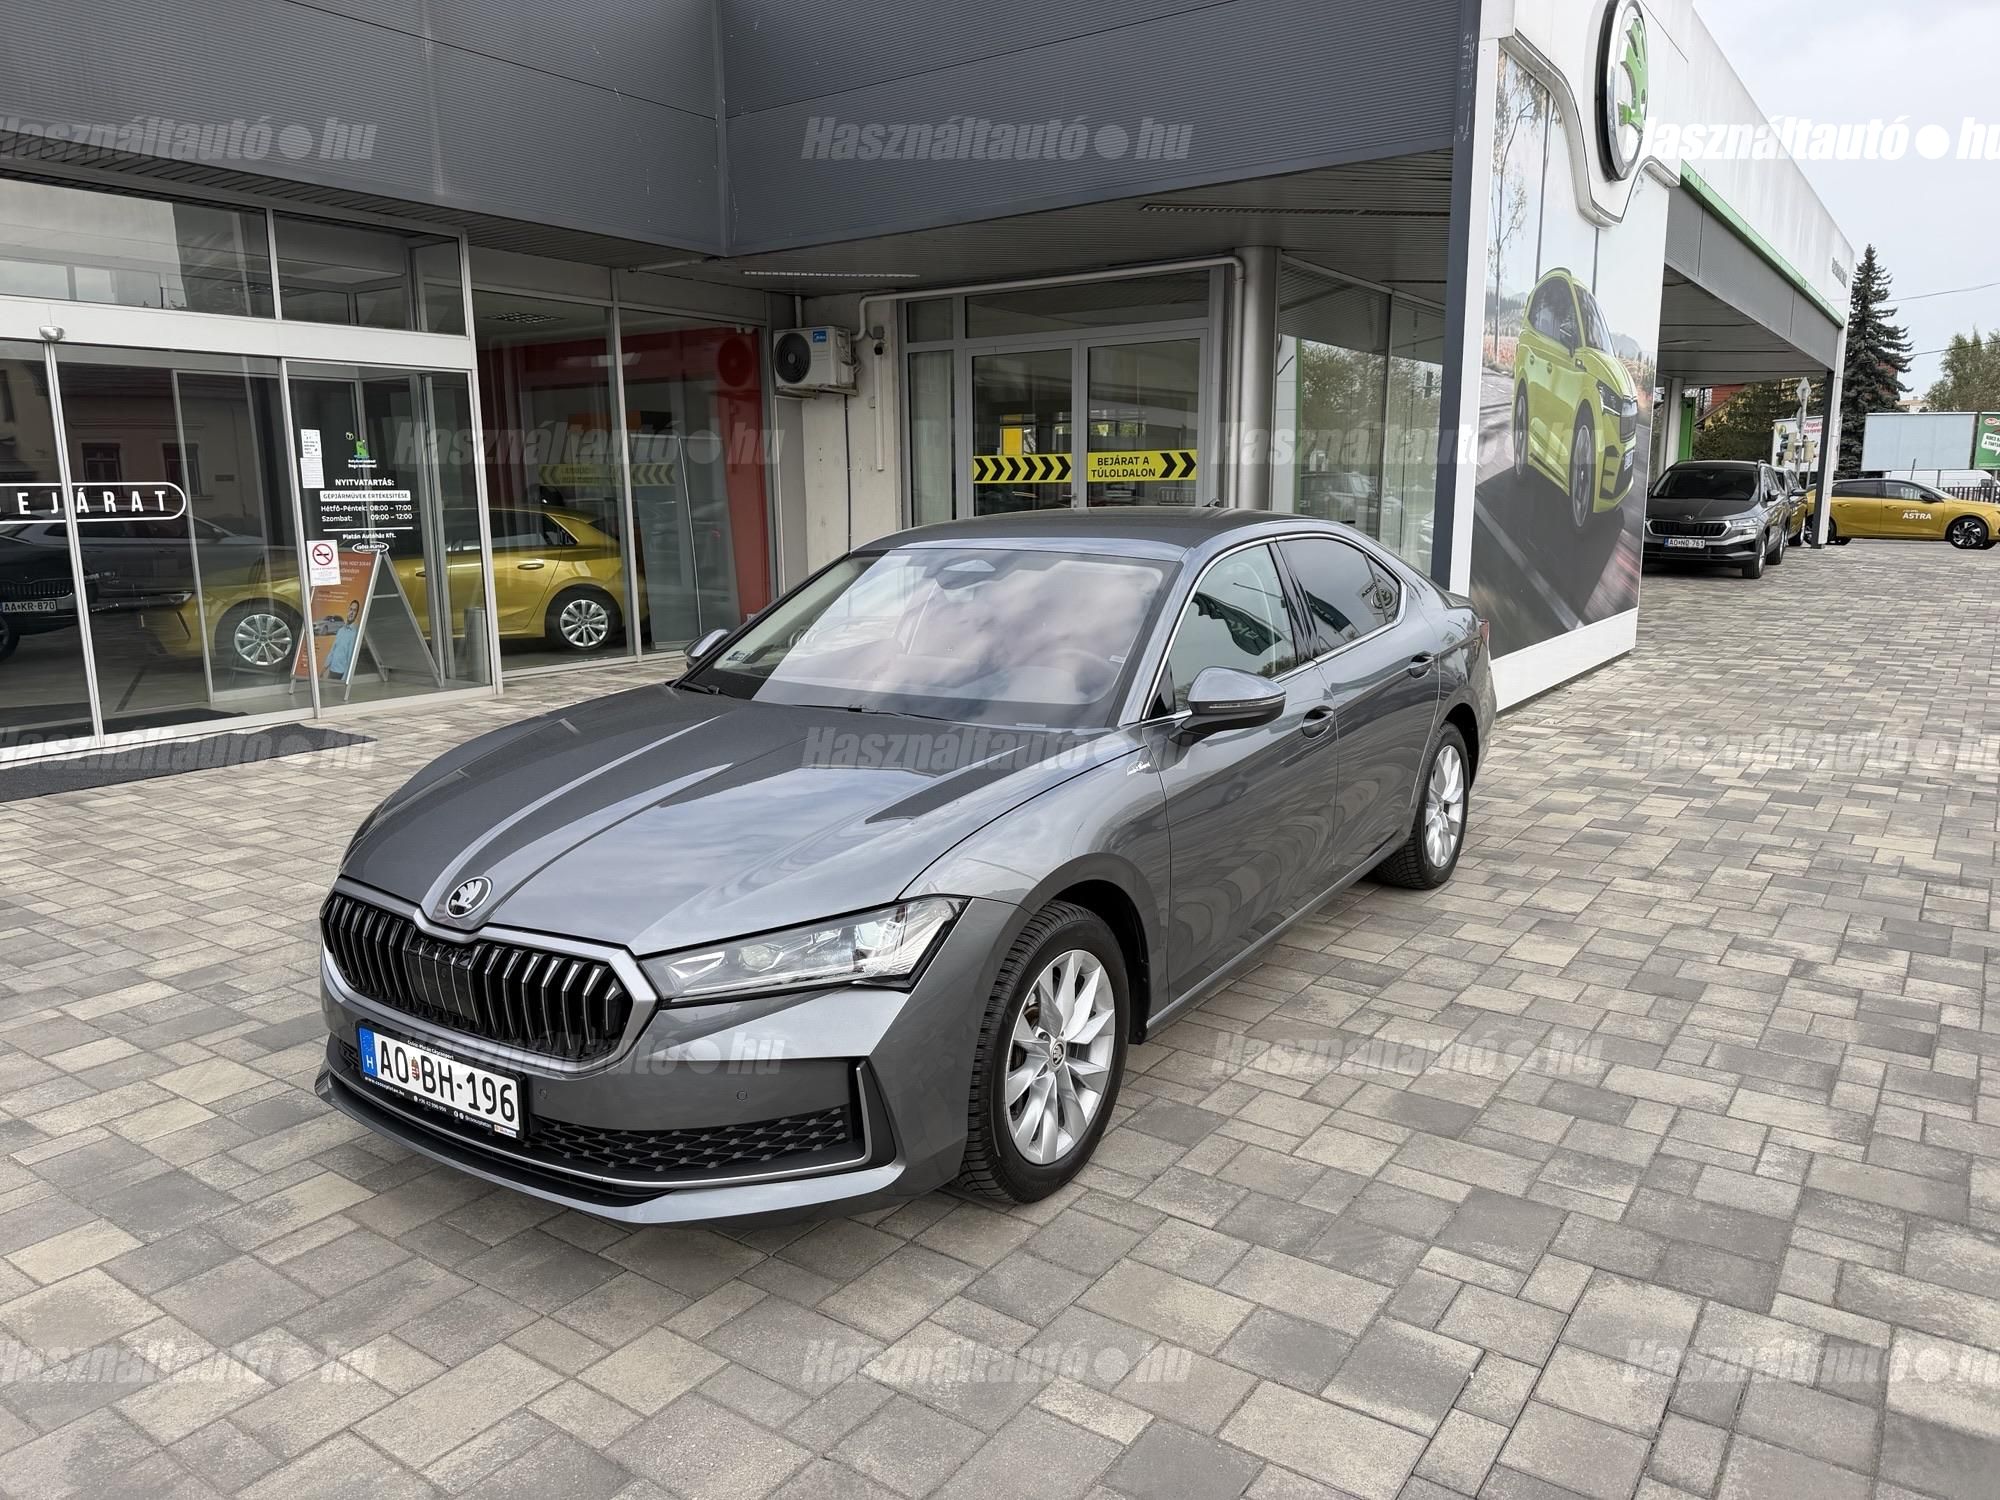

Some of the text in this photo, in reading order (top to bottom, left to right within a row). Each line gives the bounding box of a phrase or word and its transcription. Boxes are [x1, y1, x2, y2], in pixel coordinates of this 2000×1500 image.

[1097, 455, 1150, 466] BEJÁRAT A
[1091, 467, 1156, 478] TÚLOLDALON
[335, 478, 394, 486] NYITVATARTÁS:
[0, 487, 166, 515] EJÁRAT
[1902, 512, 1932, 520] ASTRA
[366, 1054, 374, 1069] H
